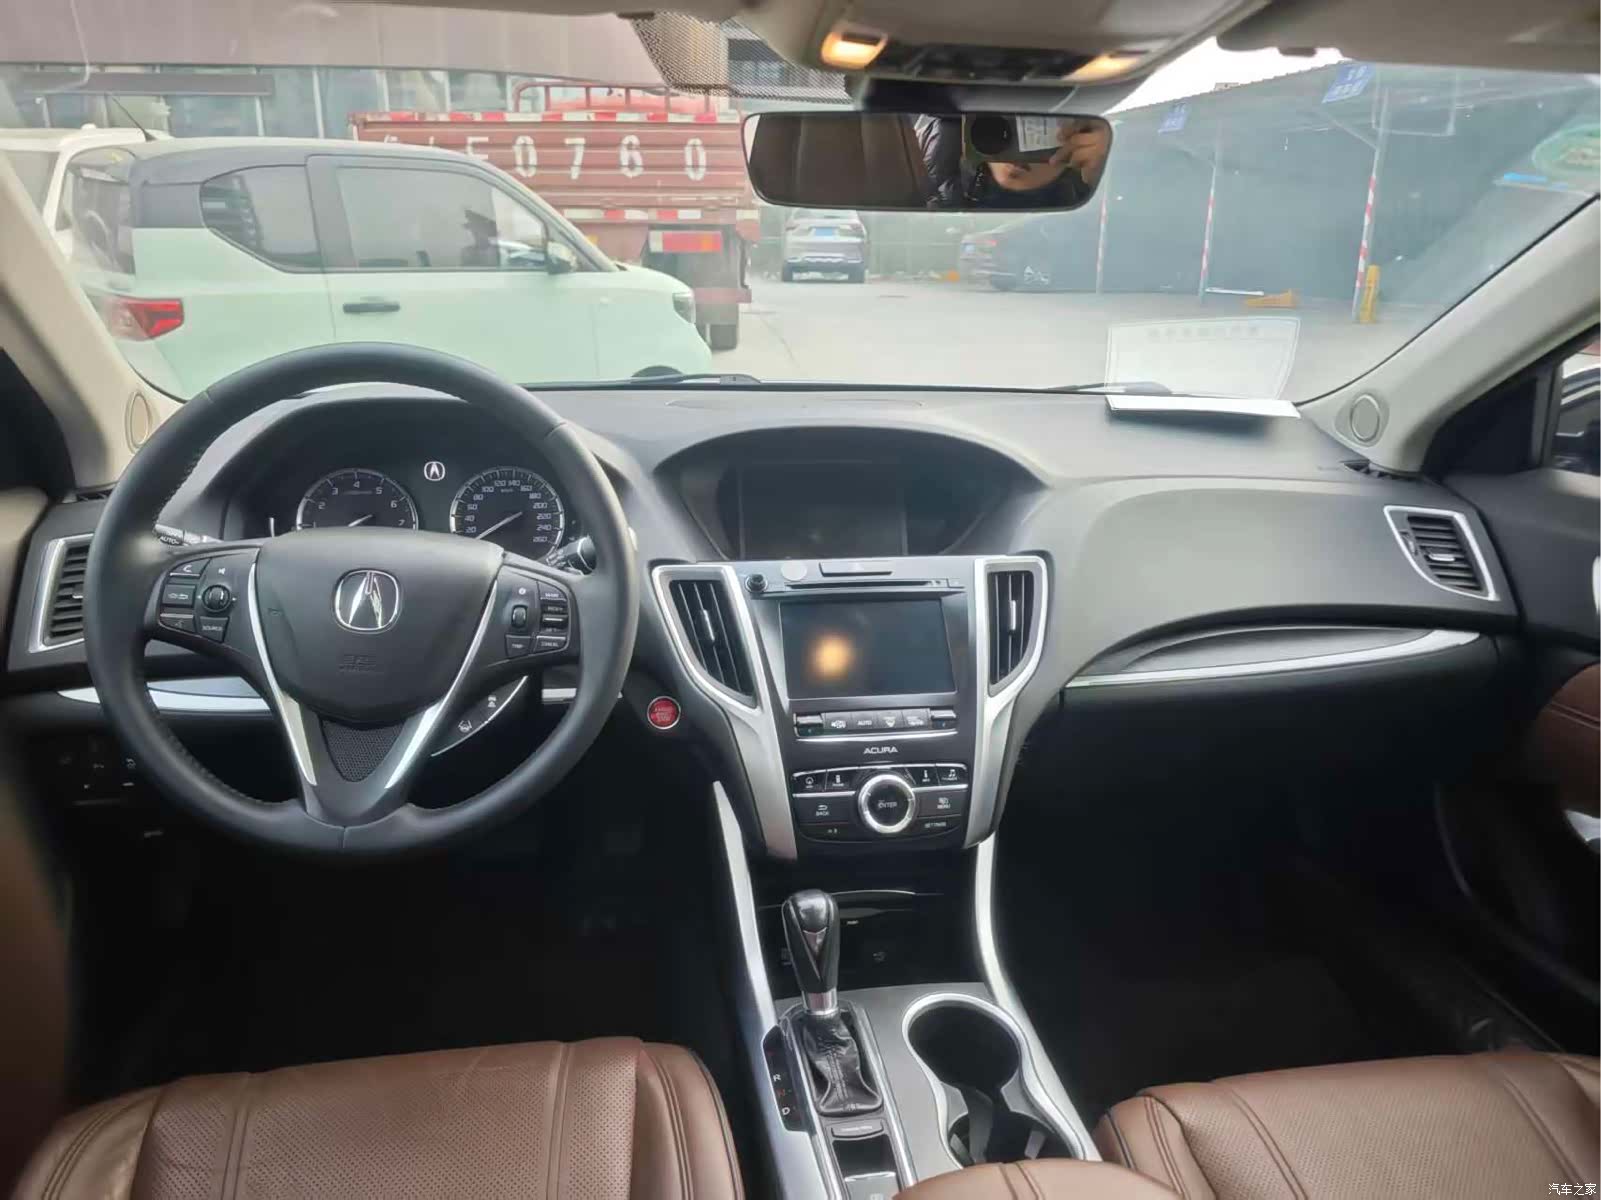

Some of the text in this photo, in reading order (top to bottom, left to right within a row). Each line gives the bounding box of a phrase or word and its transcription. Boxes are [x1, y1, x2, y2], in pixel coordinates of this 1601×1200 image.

[160, 536, 177, 545] AUTO
[863, 746, 898, 754] ACURA
[773, 1074, 782, 1082] R
[782, 1106, 791, 1115] D
